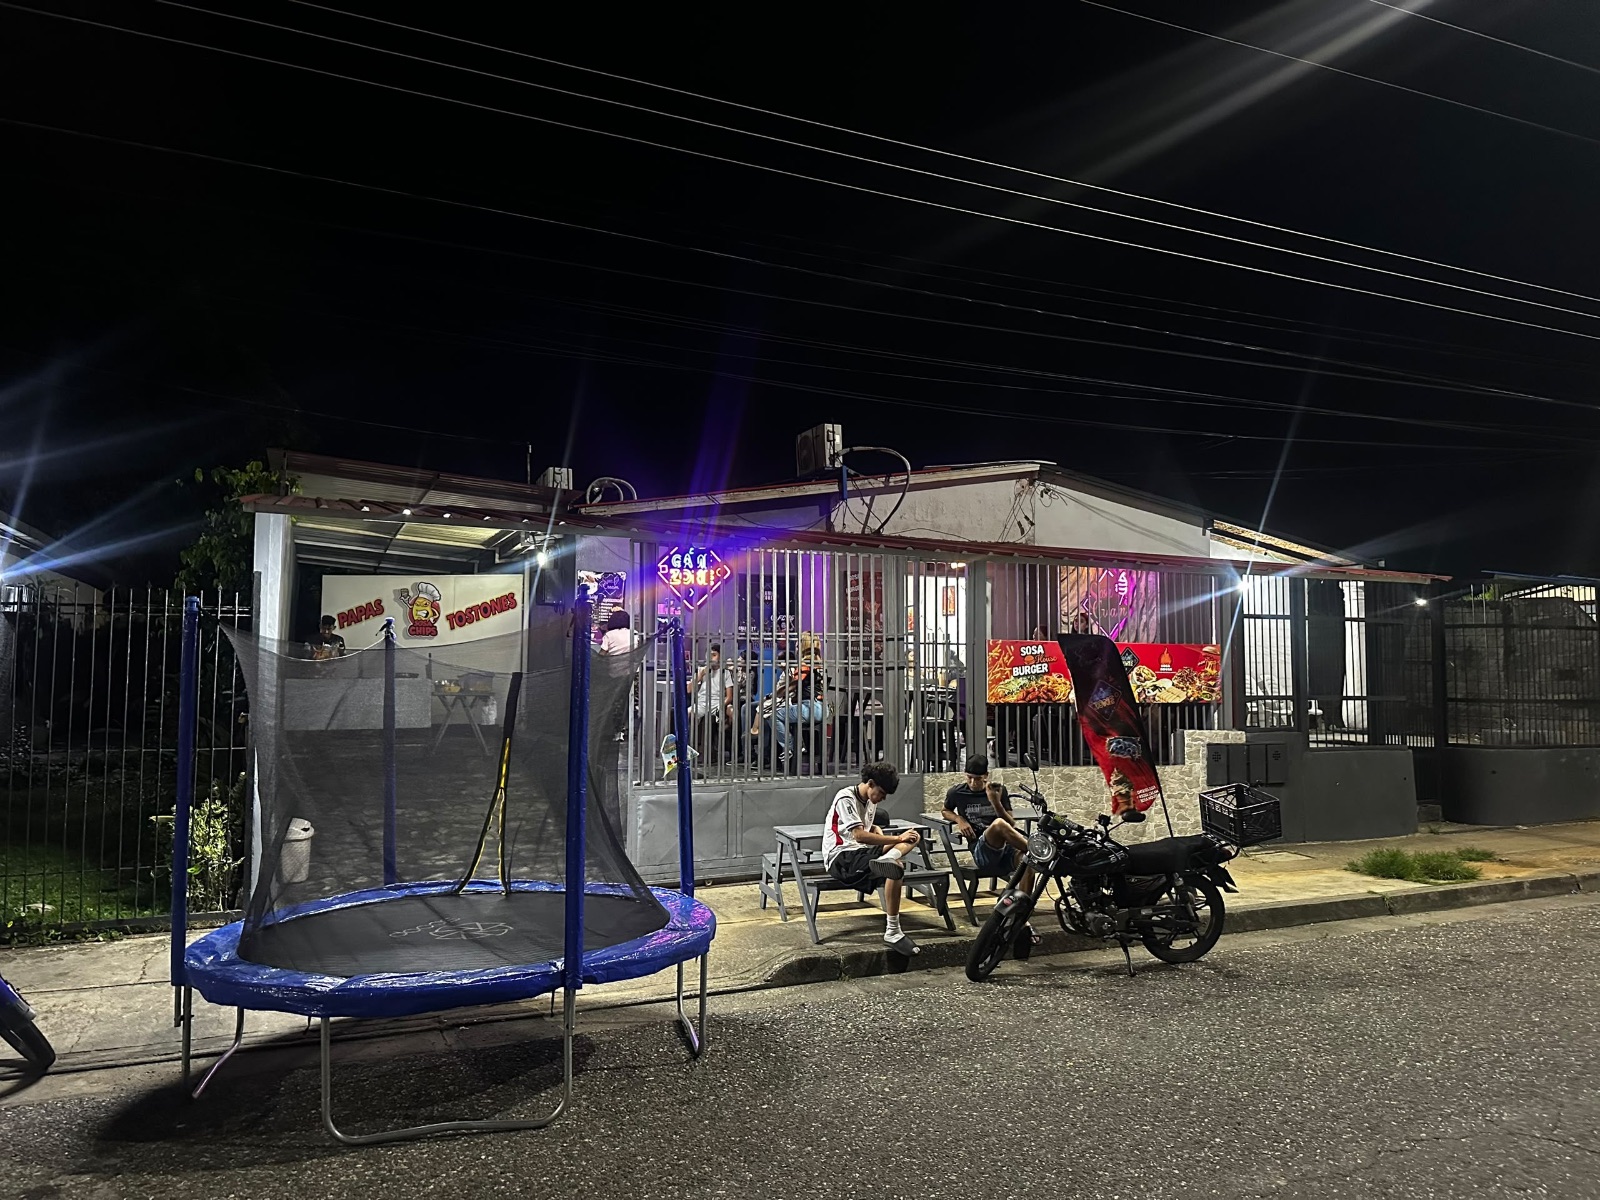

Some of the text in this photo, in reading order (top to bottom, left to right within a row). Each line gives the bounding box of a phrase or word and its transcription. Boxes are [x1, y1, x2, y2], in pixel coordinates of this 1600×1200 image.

[337, 599, 384, 629] PAPAS
[446, 593, 517, 630] TOSTONES
[408, 625, 438, 636] CHIPS
[1020, 644, 1044, 656] SOSA
[1034, 654, 1057, 664] House
[1012, 663, 1049, 677] BURGER
